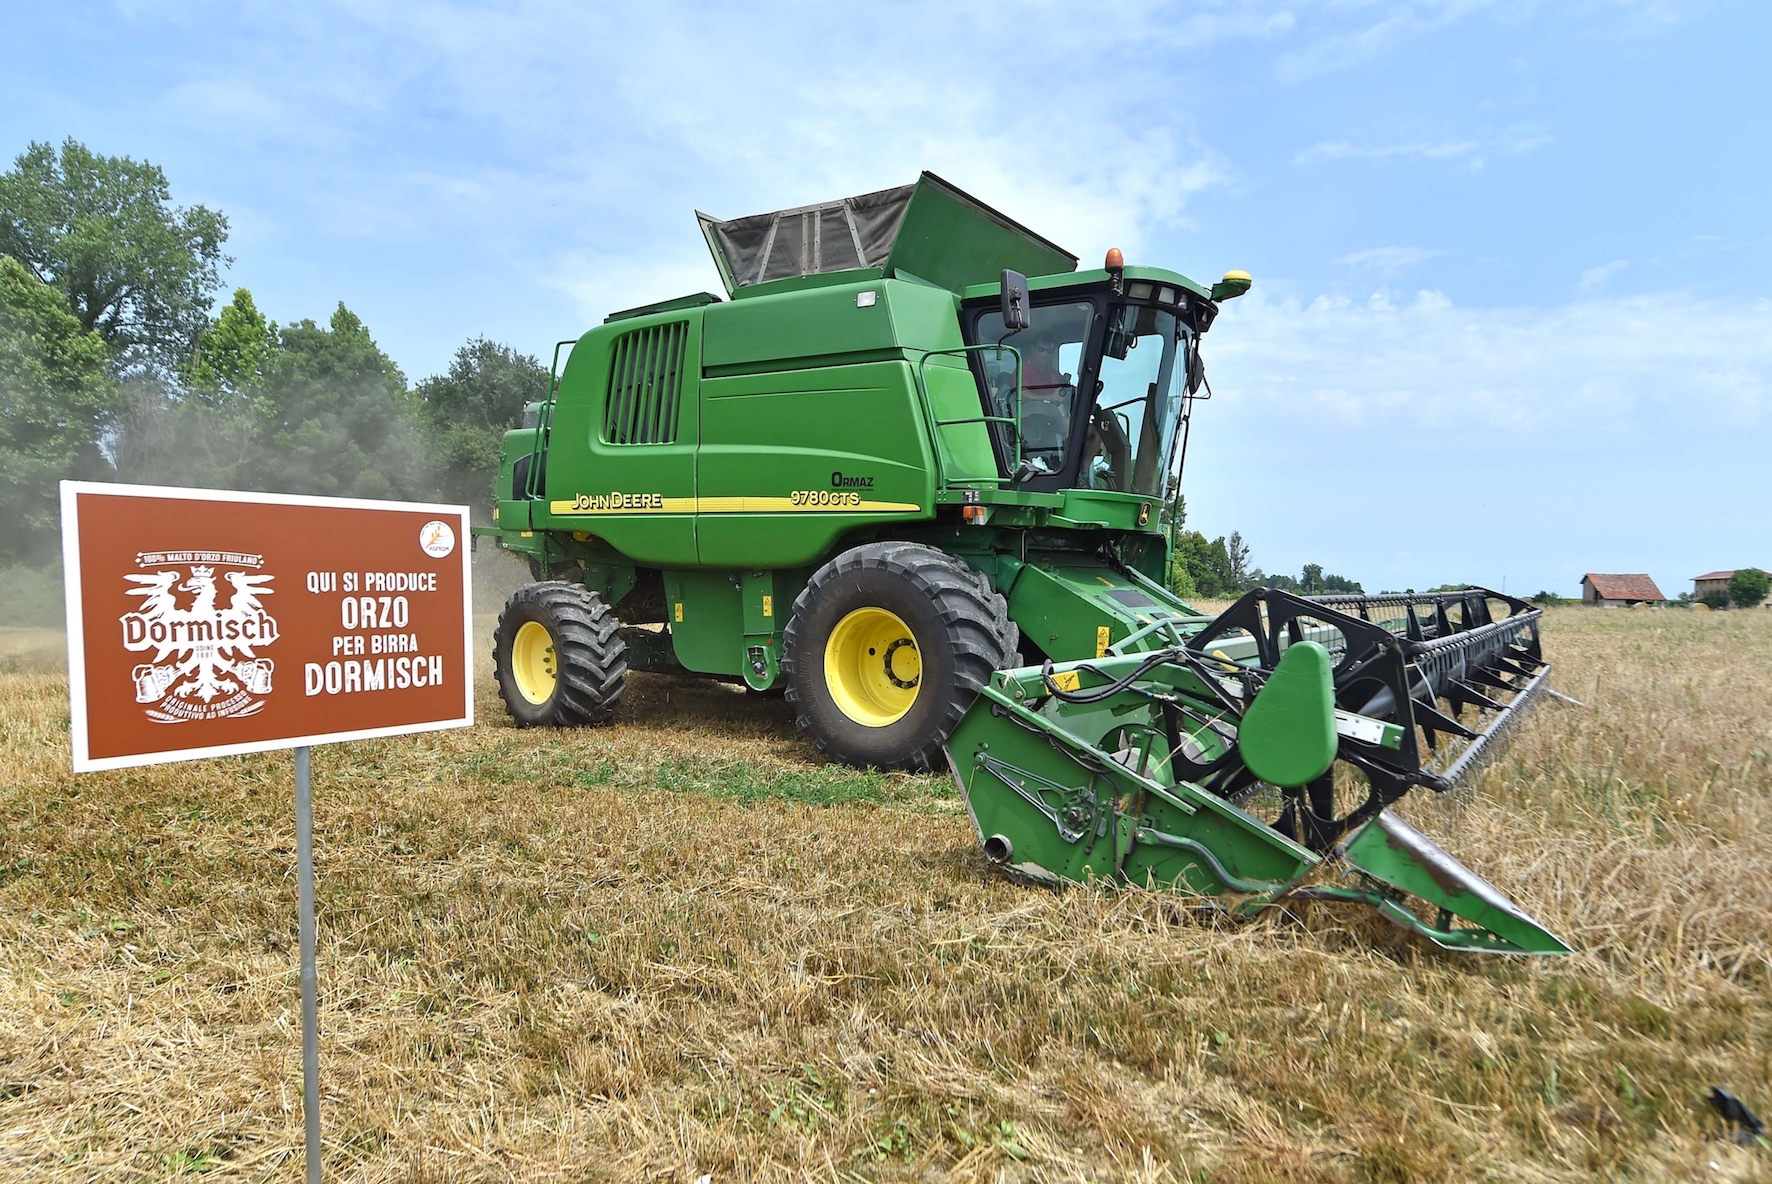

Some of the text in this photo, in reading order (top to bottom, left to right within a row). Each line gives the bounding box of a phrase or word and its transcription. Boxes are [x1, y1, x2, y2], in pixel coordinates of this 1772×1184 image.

[831, 471, 874, 488] ORMAZ
[790, 490, 861, 506] 9780CTS
[167, 553, 193, 562] MALTO
[194, 553, 220, 562] D'ORZO
[222, 554, 258, 565] FRIULANO
[306, 571, 438, 595] QUI SI PRODUCE
[341, 595, 409, 630] ORZO
[332, 633, 419, 657] PER BIRRA
[304, 654, 443, 697] DORMISCH
[159, 701, 205, 720] PRODUTTIVO
[164, 695, 208, 713] ORIGINALE
